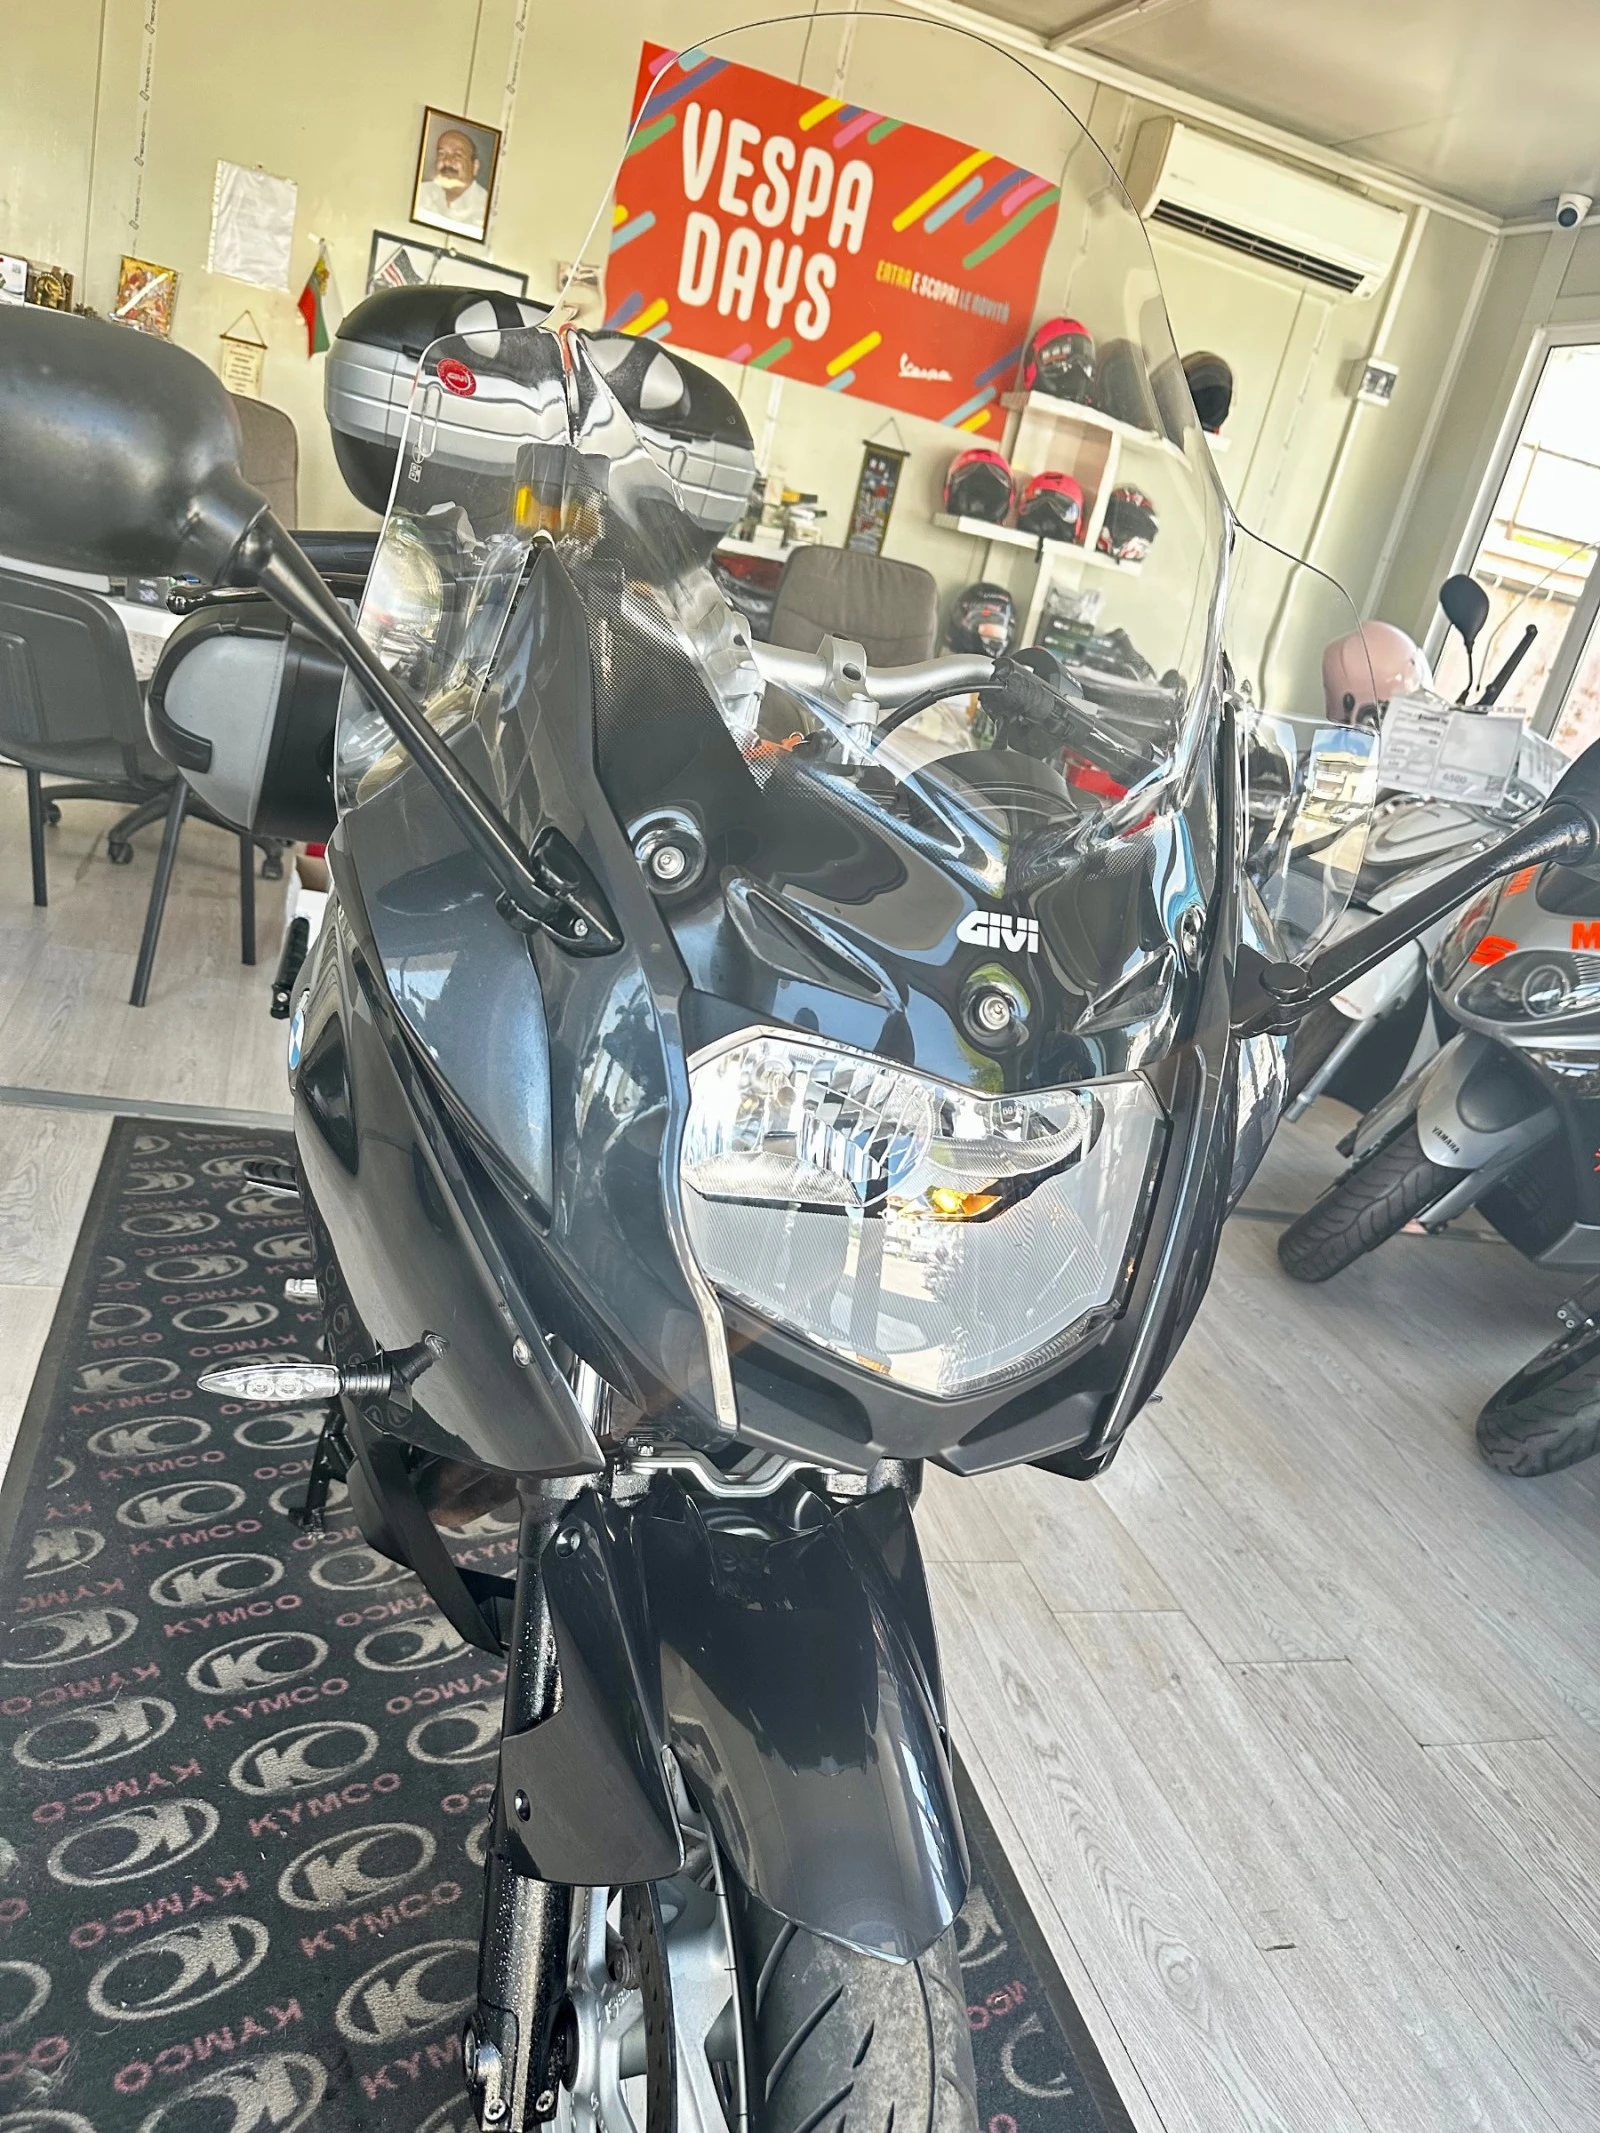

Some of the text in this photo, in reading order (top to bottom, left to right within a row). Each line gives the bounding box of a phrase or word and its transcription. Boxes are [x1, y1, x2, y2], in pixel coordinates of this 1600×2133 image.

[682, 101, 874, 255] VESPA
[676, 210, 837, 342] DAYS
[875, 259, 914, 292] ENTRA
[911, 271, 921, 295] E
[918, 274, 960, 308] SCOPRI
[956, 909, 1039, 954] GIVI
[186, 1139, 275, 1152] KYMCO
[1430, 1125, 1461, 1155] YAMAHA
[135, 1238, 238, 1258] KYMCO
[160, 1285, 267, 1305] KYMCO
[189, 1333, 299, 1358] KYMCO
[69, 1388, 193, 1416] KYMCO
[97, 1450, 226, 1482] KYMCO
[128, 1518, 263, 1557] KYMCO
[162, 1594, 303, 1638] KYMCO
[0, 1661, 161, 1716] KYMCO
[202, 1677, 350, 1732] KYMCO
[32, 1757, 203, 1825] KYMCO
[247, 1772, 402, 1838] KYMCO
[69, 1870, 250, 1949] KYMCO
[300, 1880, 463, 1959] KYMCO
[114, 1997, 304, 2094] KYMCO
